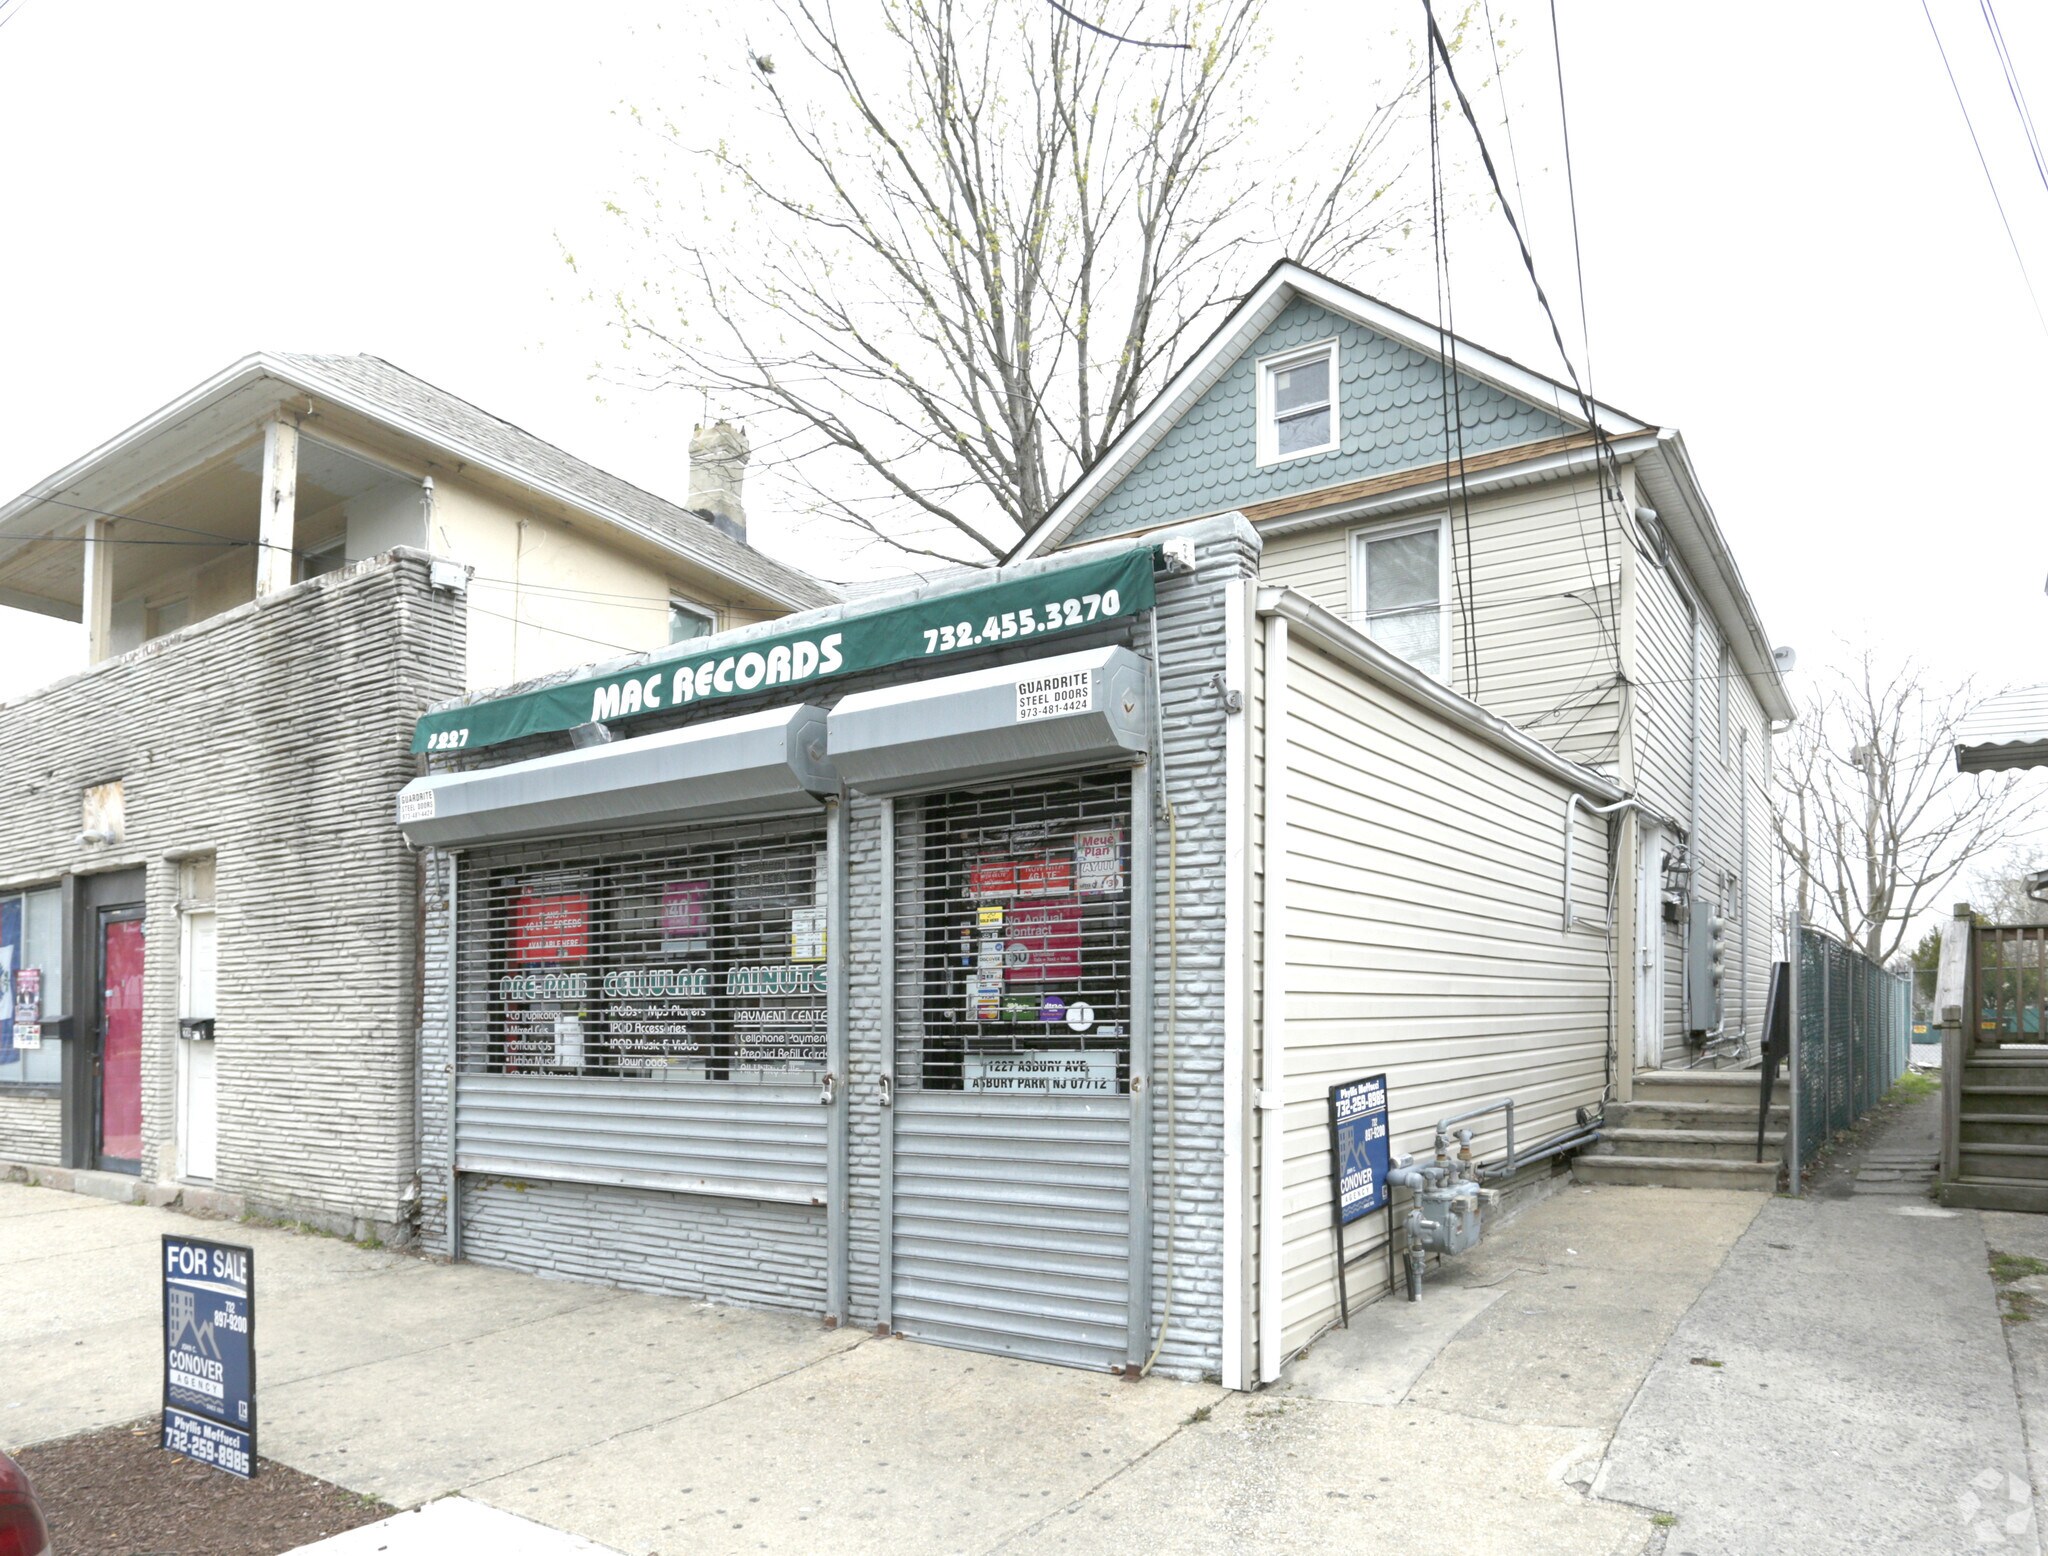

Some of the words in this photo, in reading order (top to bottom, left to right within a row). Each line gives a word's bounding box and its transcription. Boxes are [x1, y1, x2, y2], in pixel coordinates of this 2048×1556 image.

[923, 589, 1120, 654] 732.455.3270
[590, 673, 661, 723] MAC
[672, 632, 843, 704] RECORDS
[1018, 672, 1089, 695] GUARDRITE
[1019, 691, 1049, 708] STEEL
[1054, 687, 1088, 702] DOORS
[1020, 699, 1087, 719] 973-481-4424
[428, 729, 469, 750] 1227
[401, 791, 433, 804] GUARDRITE
[1085, 847, 1110, 857] Plan
[1005, 916, 1020, 925] No
[1024, 913, 1063, 924] Annual
[1005, 925, 1052, 937] Contract
[528, 940, 561, 949] AVAIABLE
[500, 972, 588, 1000] PRE-PAID
[603, 968, 707, 997] CELLULAR
[647, 1005, 669, 1019] Mp3
[671, 1004, 707, 1017] Players
[734, 1010, 787, 1023] PAYMENT
[534, 1025, 549, 1034] Cs
[610, 1022, 633, 1034] IPOD
[609, 1038, 633, 1050] IPOD
[634, 1038, 660, 1051] Music
[672, 1039, 699, 1051] Video
[739, 1033, 785, 1045] Cellphone
[777, 1047, 801, 1059] Refill
[617, 1056, 668, 1067] Downoads
[988, 1060, 1015, 1072] 1227
[1017, 1060, 1062, 1072] ASBURY
[1052, 1077, 1067, 1089] NJ
[1070, 1077, 1107, 1090] 07712
[1340, 1167, 1373, 1195] CONOVER
[1344, 1185, 1371, 1204] AGENCY
[167, 1246, 208, 1277] FOR
[213, 1249, 248, 1285] SALE
[225, 1300, 236, 1314] 732
[214, 1310, 248, 1335] 897-9200
[169, 1349, 224, 1383] CONOVER
[176, 1373, 218, 1395] AGENCY
[174, 1415, 202, 1437] Phyllis
[203, 1425, 241, 1449] Maffucci
[165, 1427, 250, 1475] 732-259-8985
